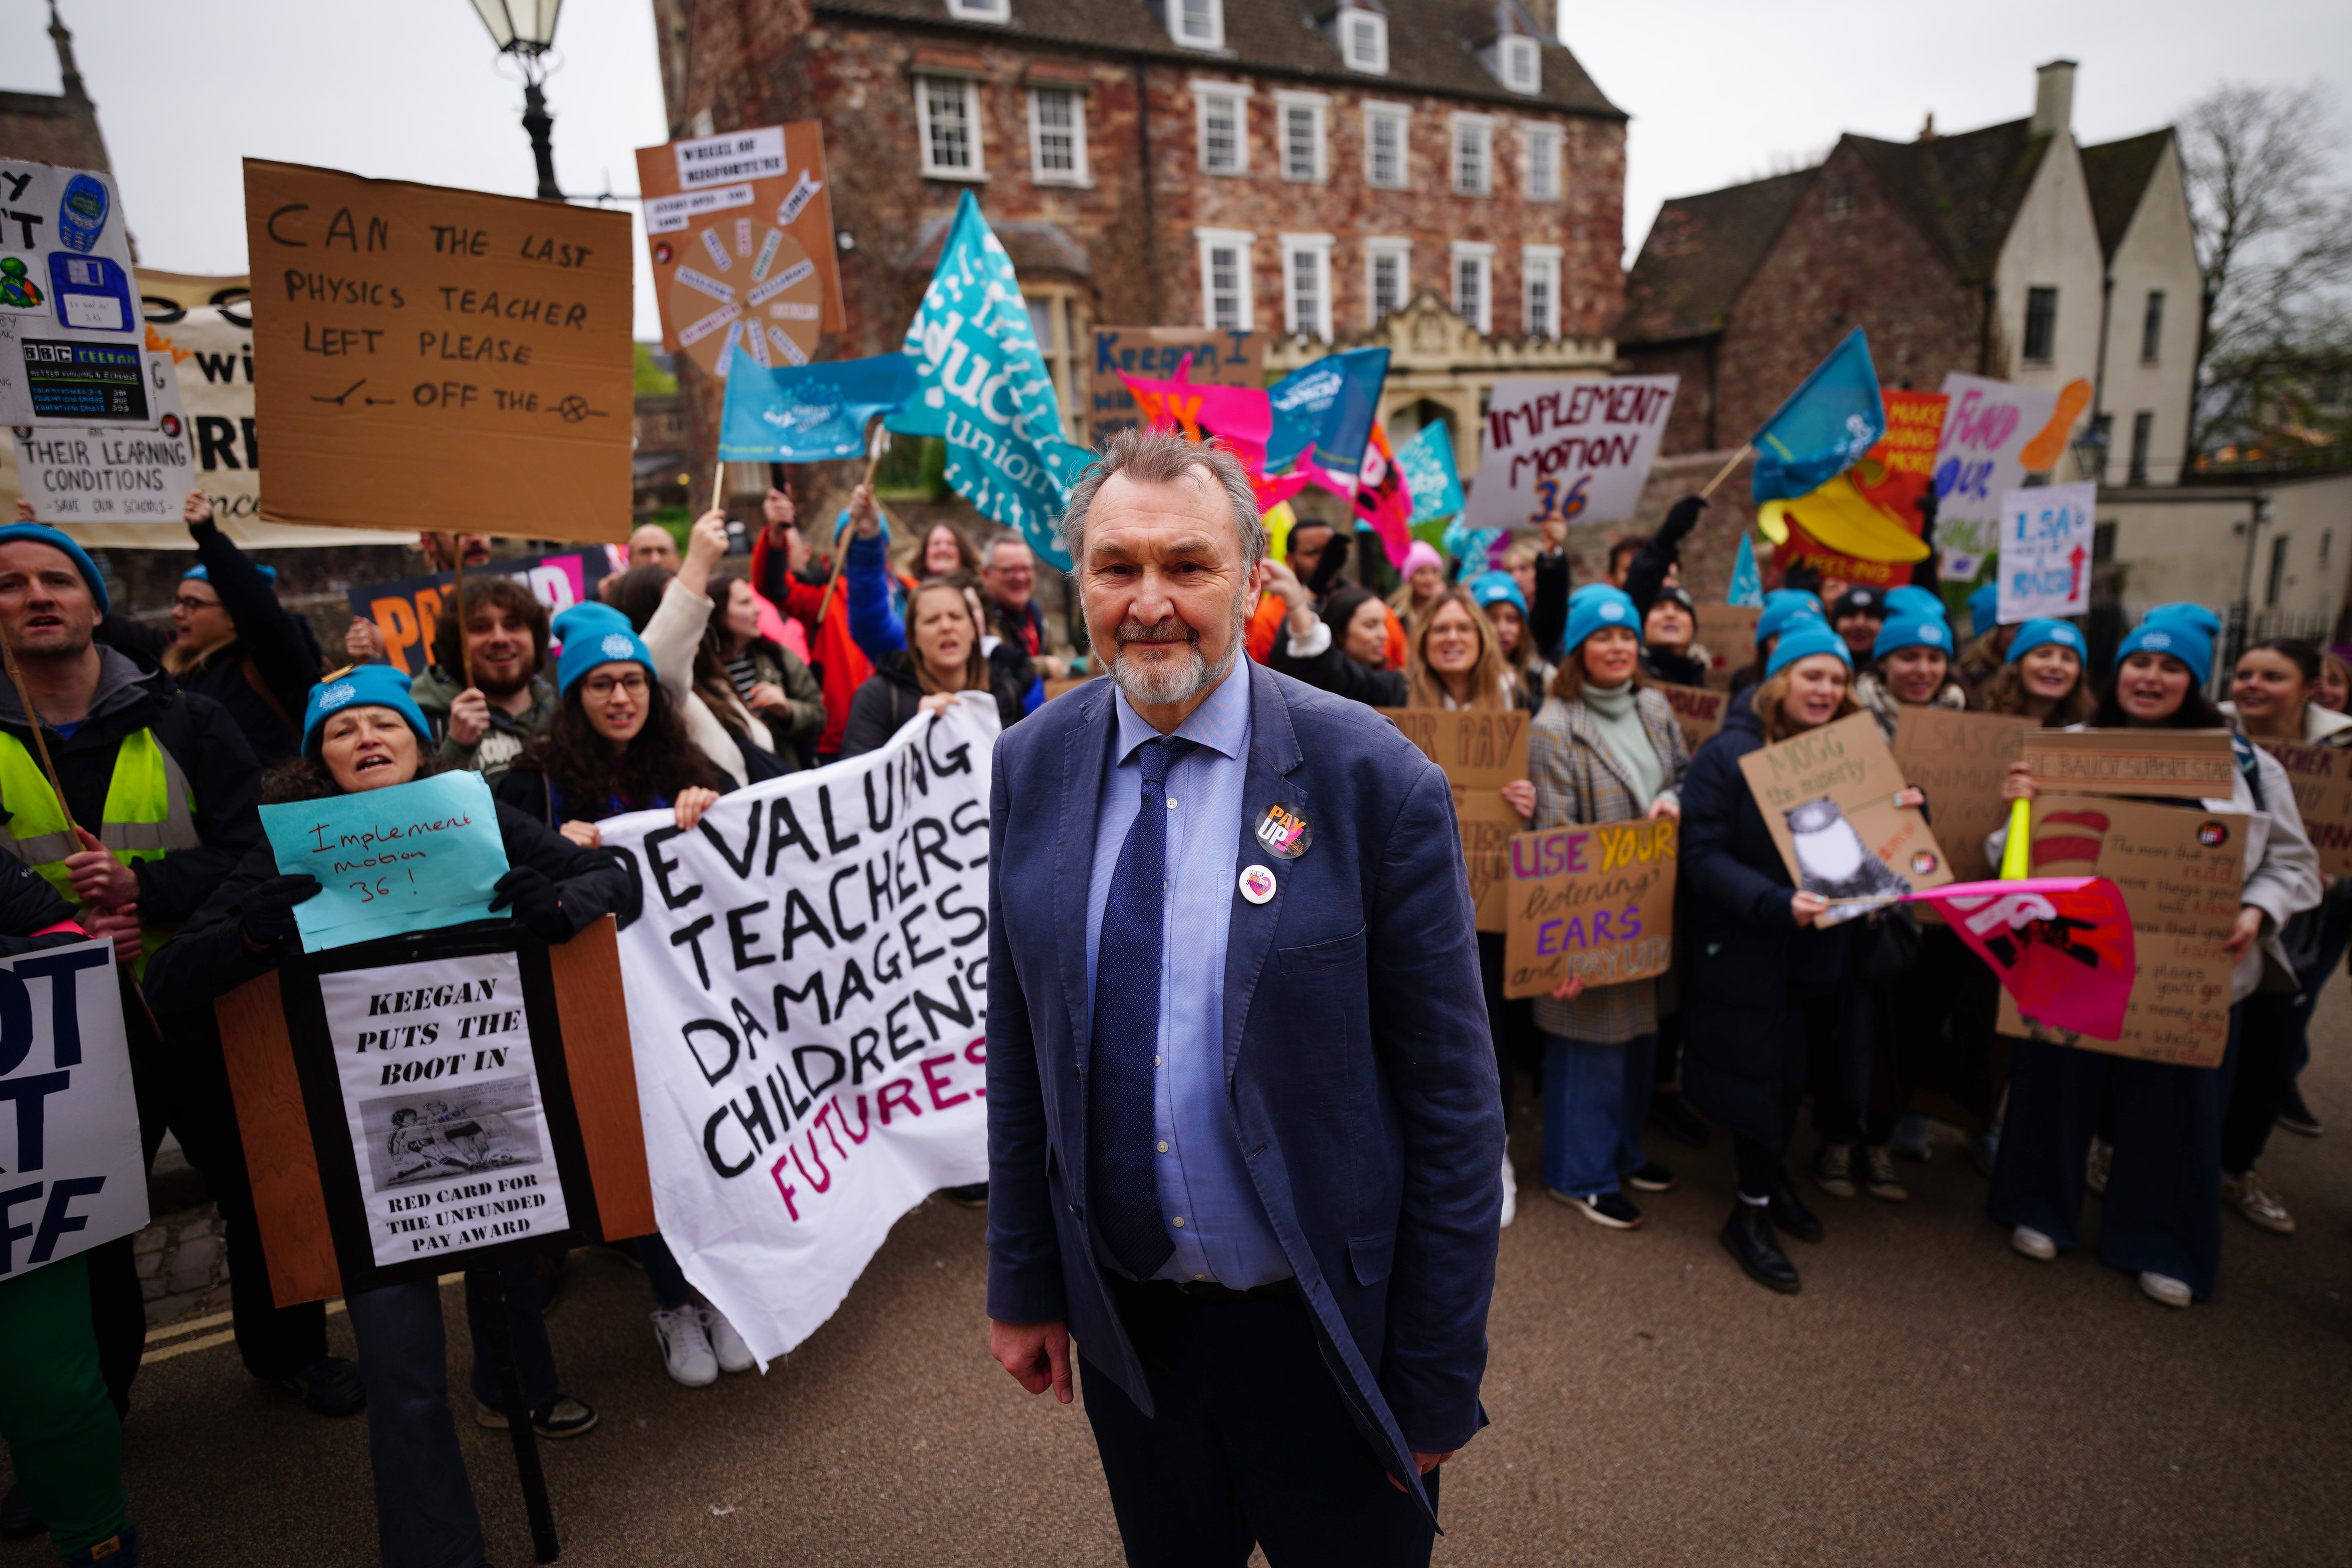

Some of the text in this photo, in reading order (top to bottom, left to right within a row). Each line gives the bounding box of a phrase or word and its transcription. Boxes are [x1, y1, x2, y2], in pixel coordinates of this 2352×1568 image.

[266, 203, 592, 268] CAN THE LAST
[284, 268, 406, 309] PHYSICS
[440, 286, 588, 330] TEACHER
[304, 322, 534, 366] LEFT PLEASE
[413, 381, 538, 412] OFF THE
[1488, 384, 1673, 450] IMPLEMENT
[23, 440, 187, 467] THEIR LEARNING
[1510, 434, 1640, 489] MOTION
[43, 468, 164, 492] CONDITIONS
[1530, 474, 1593, 523] 36
[1459, 714, 1522, 768] PAY
[308, 811, 472, 853] Implement
[1267, 805, 1307, 834] PAY
[334, 850, 426, 873] motion
[1512, 832, 1591, 880] USE
[1598, 820, 1677, 874] YOUR
[349, 879, 390, 904] 36
[670, 799, 990, 990] TEACHERS
[1246, 879, 1268, 892] SCHOOLS
[1536, 905, 1642, 957] EARS
[367, 978, 498, 1017] KEEGAN
[682, 884, 987, 1087] DAMAGES
[356, 1009, 522, 1054] PUTS THE
[379, 1047, 511, 1086] BOOT IN
[386, 1193, 546, 1235] THE UNFUNDED
[388, 1173, 539, 1214] RED CARD FOR
[412, 1218, 531, 1253] PAY AWARD
